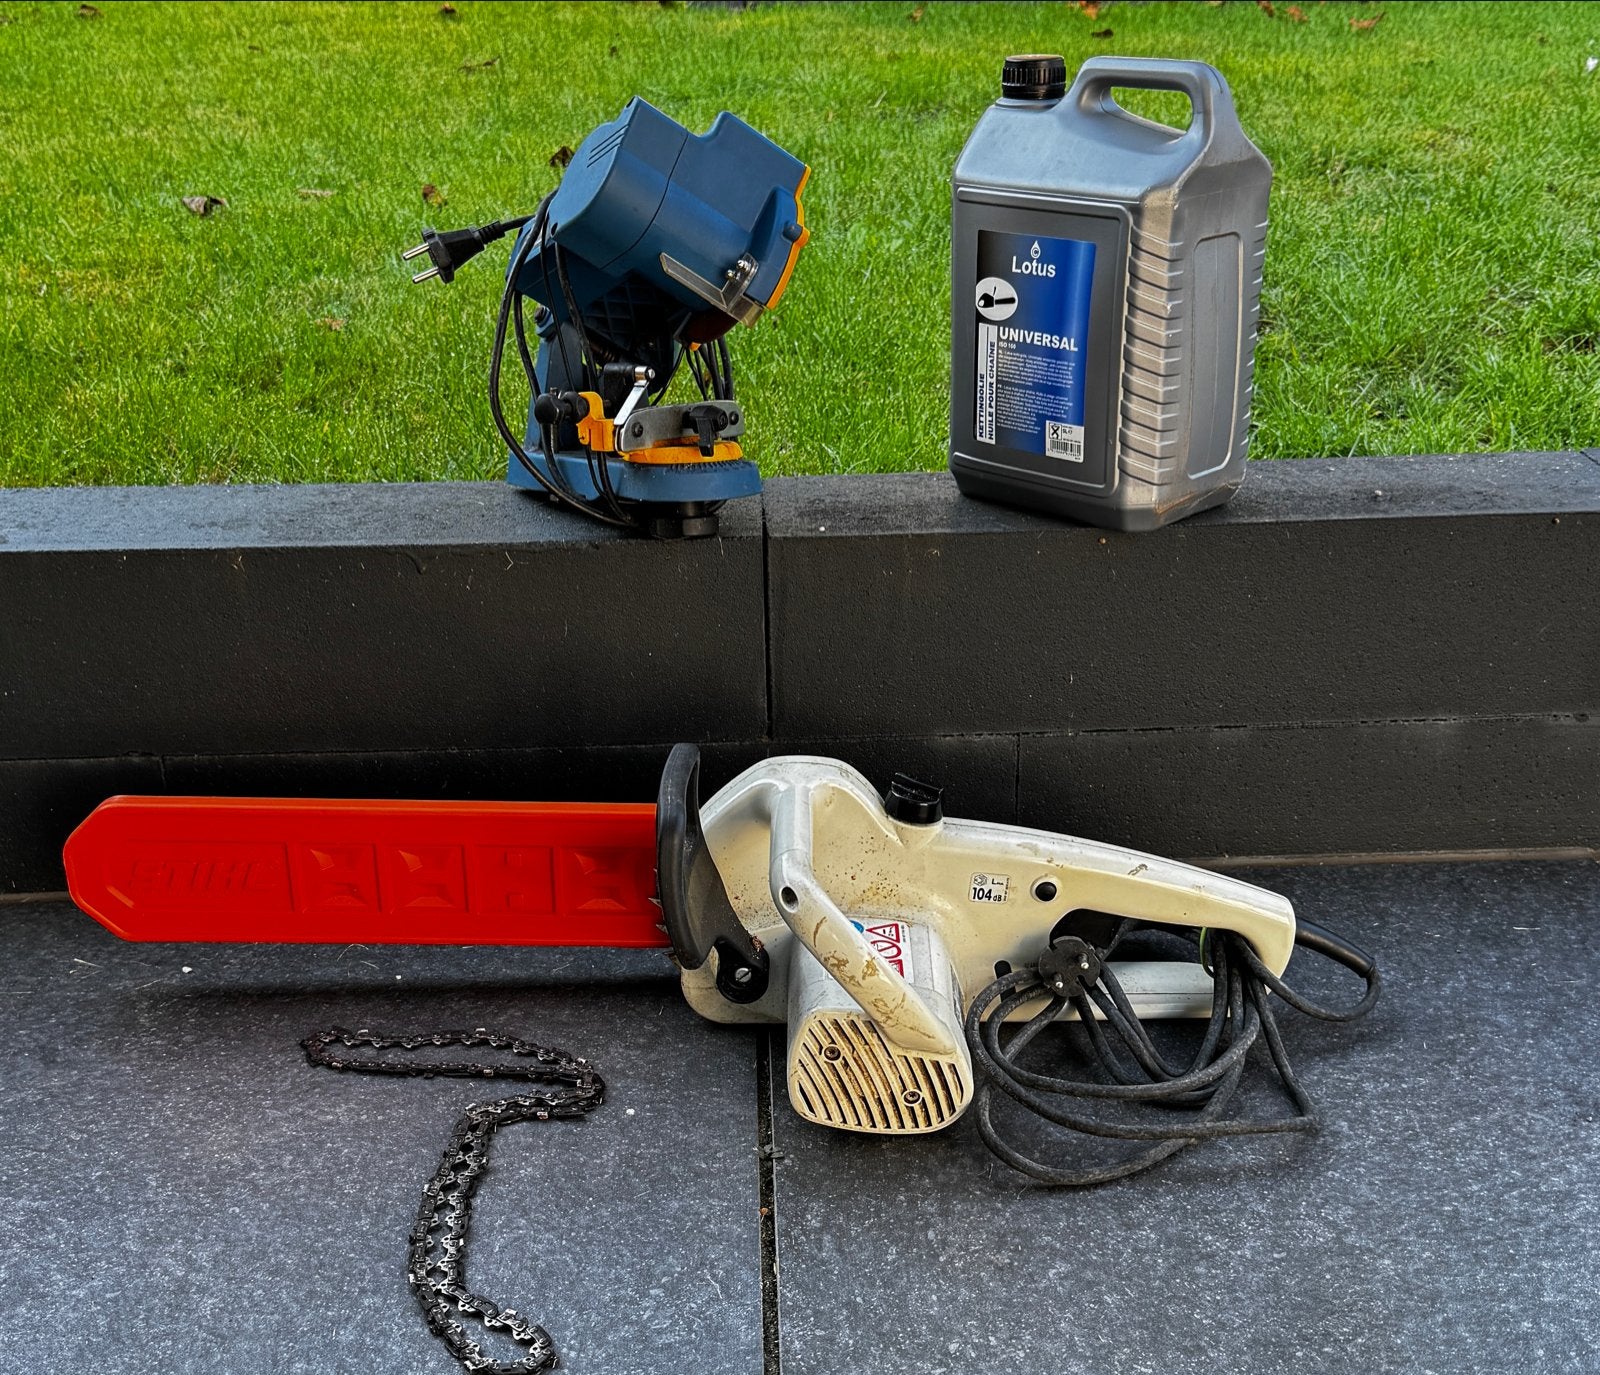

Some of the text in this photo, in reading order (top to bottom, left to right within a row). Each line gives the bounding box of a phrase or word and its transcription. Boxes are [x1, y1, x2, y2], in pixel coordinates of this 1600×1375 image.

[1011, 255, 1056, 278] Lotus
[999, 326, 1078, 352] UNIVERSAL
[988, 341, 996, 379] CHAÎNE
[127, 859, 279, 895] STIHL
[972, 886, 992, 901] 104
[992, 894, 1002, 902] dB
